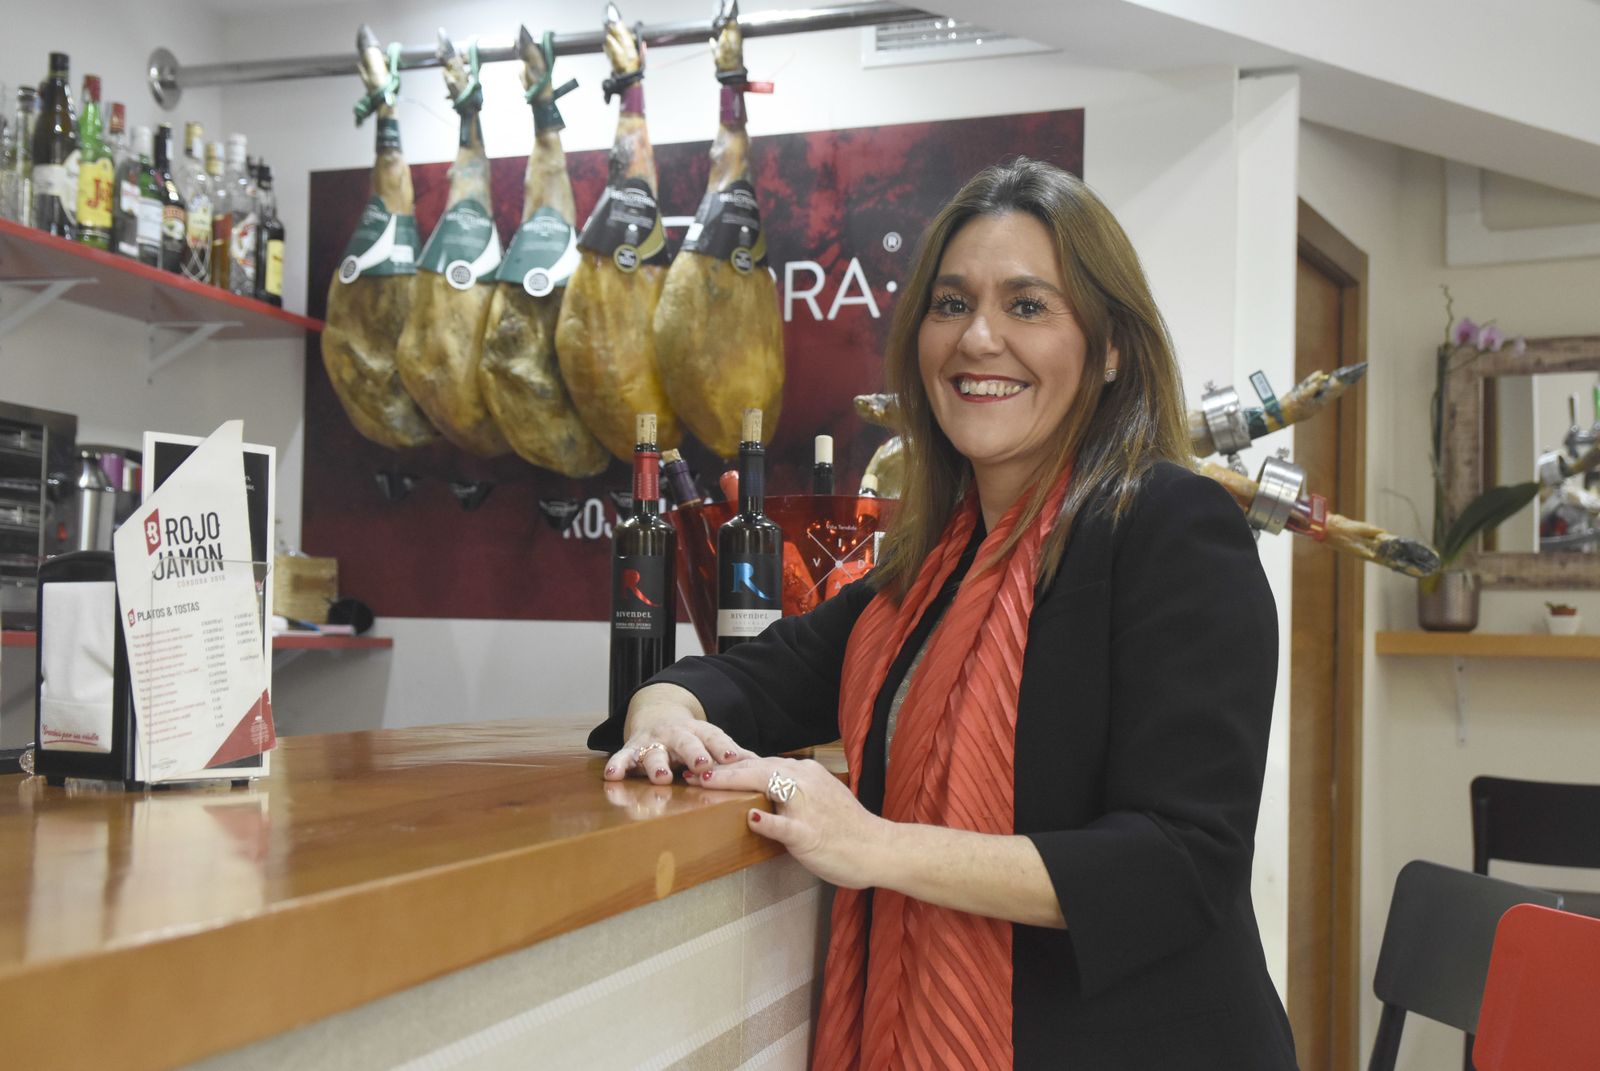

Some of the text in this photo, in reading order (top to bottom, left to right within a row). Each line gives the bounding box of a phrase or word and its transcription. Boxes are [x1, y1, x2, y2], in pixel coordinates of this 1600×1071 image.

[165, 512, 220, 546] ROJO
[623, 567, 662, 608] R
[730, 562, 770, 600] R
[137, 607, 165, 621] PLATOS
[166, 606, 172, 617] &
[174, 601, 200, 615] TOSTAS
